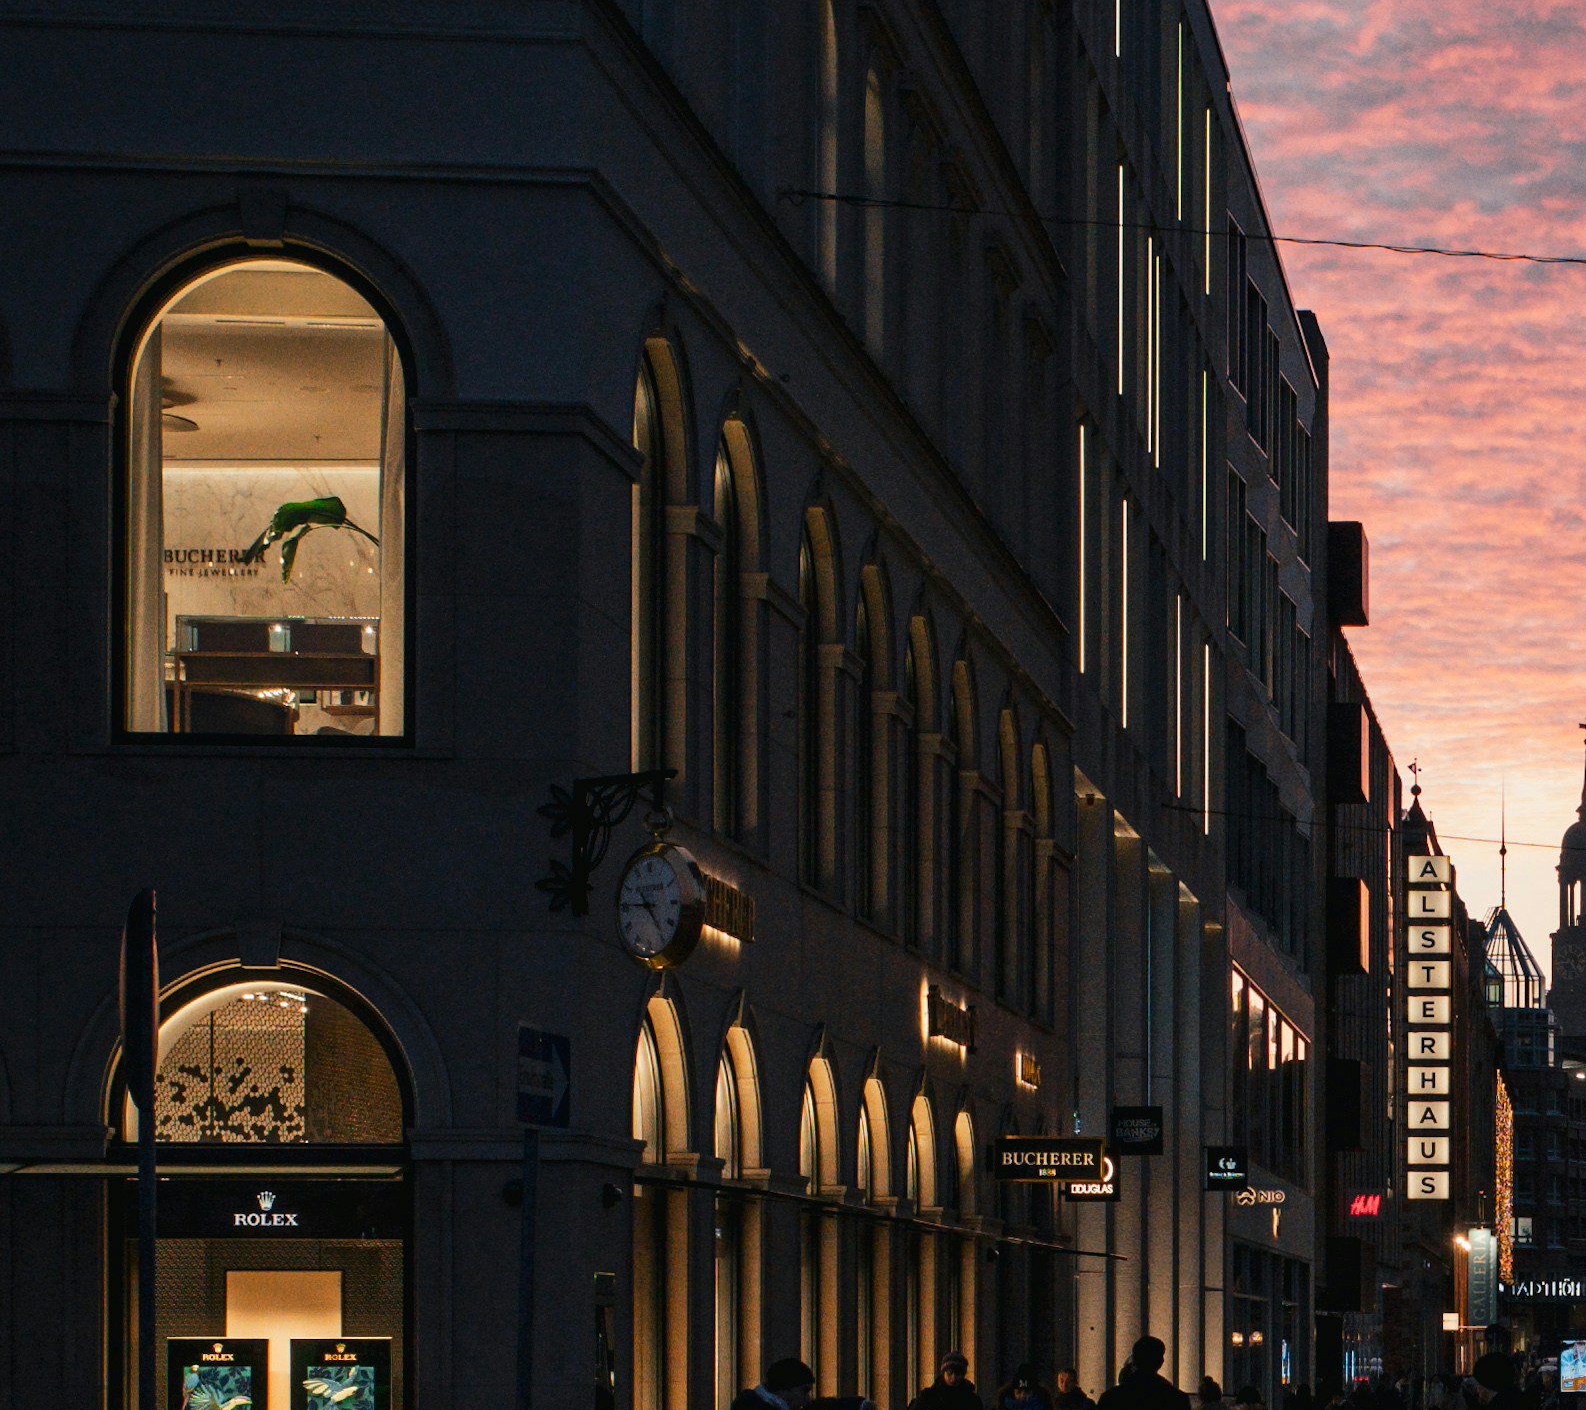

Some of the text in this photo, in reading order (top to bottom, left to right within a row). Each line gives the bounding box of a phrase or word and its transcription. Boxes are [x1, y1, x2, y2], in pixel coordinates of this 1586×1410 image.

[164, 549, 266, 564] BUCHERR
[1420, 860, 1437, 1194] ALSTERHAUS
[1001, 1151, 1095, 1166] BUCHERER
[1071, 1184, 1114, 1194] DOUGLAS
[1259, 1190, 1286, 1204] NIO
[233, 1212, 299, 1227] ROLEX
[1472, 1232, 1487, 1322] GALLERIA
[202, 1353, 235, 1362] ROLEX
[324, 1352, 358, 1362] ROLEX
